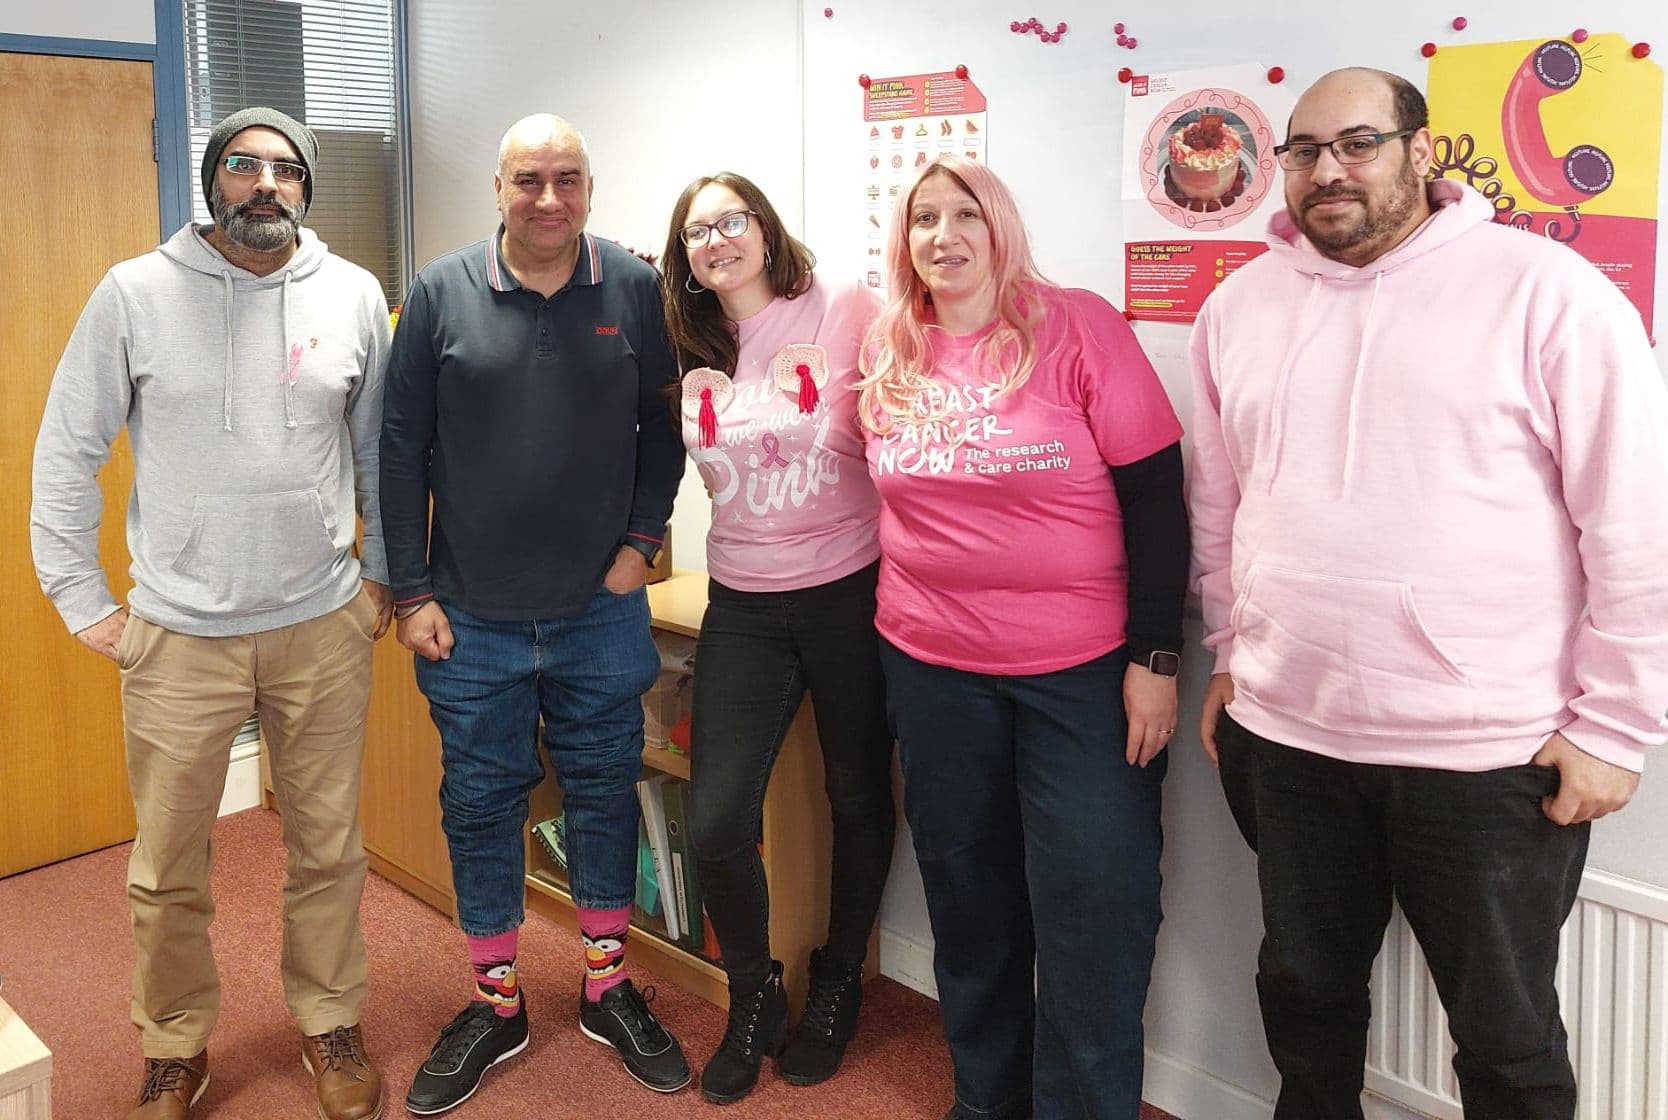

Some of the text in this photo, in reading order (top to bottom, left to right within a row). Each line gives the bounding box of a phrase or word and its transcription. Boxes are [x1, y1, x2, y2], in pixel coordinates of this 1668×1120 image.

[1166, 245, 1192, 253] WEIGHT
[964, 439, 1065, 461] The research
[877, 447, 956, 476] NOW
[964, 456, 1071, 474] & care charity
